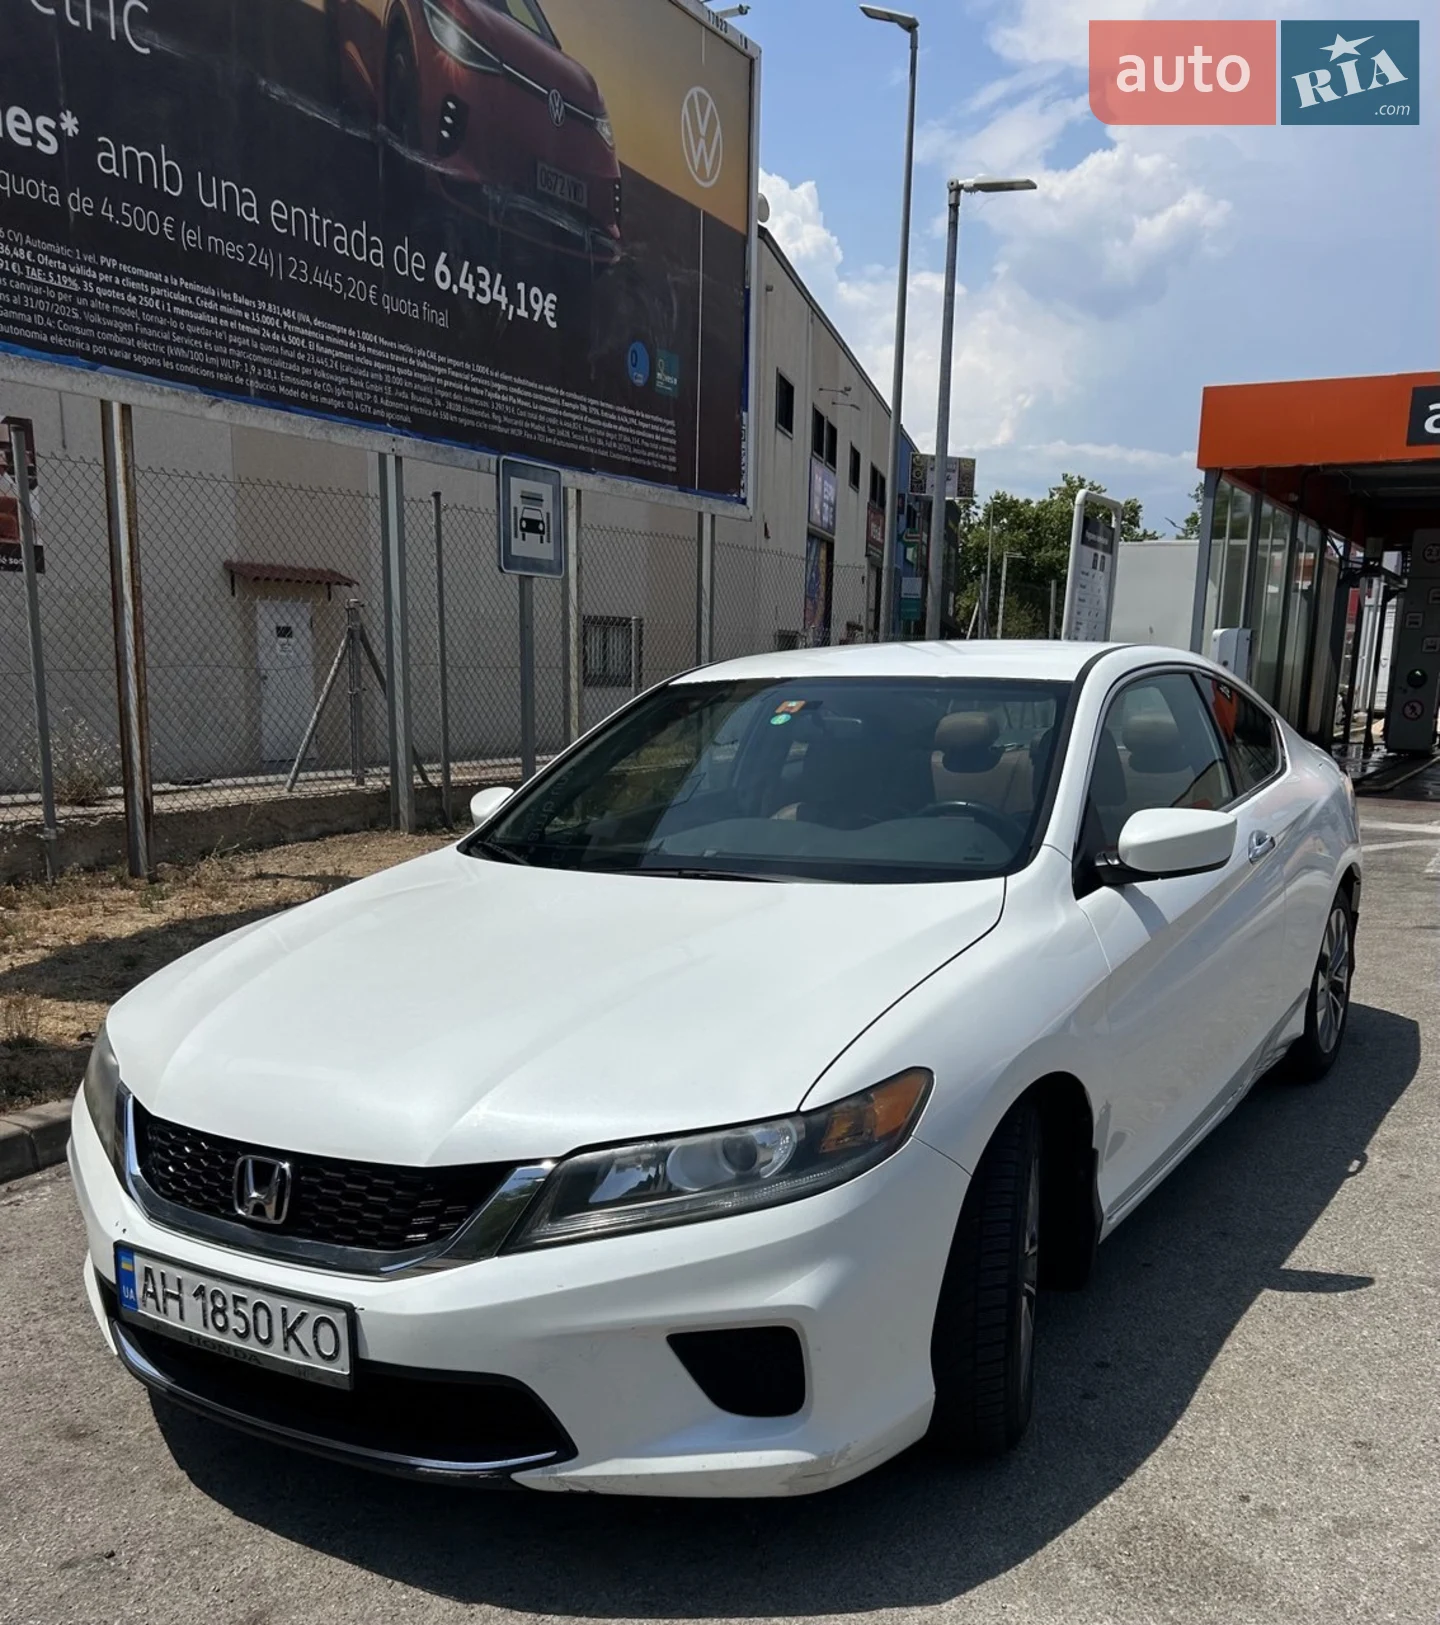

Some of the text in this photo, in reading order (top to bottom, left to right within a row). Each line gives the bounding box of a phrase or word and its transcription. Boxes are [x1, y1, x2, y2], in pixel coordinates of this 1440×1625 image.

[0, 169, 60, 206] quota
[67, 187, 94, 216] de
[100, 197, 175, 241] 4.500€
[181, 219, 203, 252] (el
[208, 236, 245, 263] mes
[288, 256, 379, 306] 23.445,20€
[381, 292, 420, 321] quota
[422, 301, 450, 329] final
[97, 136, 184, 197] amb
[198, 171, 260, 225] una
[270, 199, 385, 269] entrada
[393, 235, 426, 282] de
[434, 252, 559, 329] 6.434,19€
[37, 252, 67, 270] Oferta
[98, 271, 113, 283] per
[114, 276, 120, 285] a
[121, 277, 148, 292] clients
[150, 286, 194, 304] particulars.
[99, 255, 117, 269] PVP
[118, 262, 162, 282] recomanat
[163, 275, 169, 284] a
[170, 275, 177, 286] la
[9, 280, 55, 299] canviar-lo
[57, 292, 71, 303] per
[76, 296, 88, 307] un
[89, 298, 110, 312] altre
[112, 305, 140, 321] model,
[179, 322, 184, 330] o
[24, 265, 46, 280] TAE:
[82, 280, 93, 293] 35
[95, 286, 125, 301] quotes
[126, 292, 136, 304] de
[219, 318, 228, 328] en
[229, 320, 236, 330] el
[56, 319, 94, 338] Consum
[83, 310, 133, 332] Volkswagen
[135, 323, 170, 341] Financial
[171, 332, 202, 348] Services
[92, 343, 106, 354] pot
[132, 353, 161, 366] segons
[162, 357, 173, 369] les
[122, 1285, 136, 1302] UA
[140, 1264, 341, 1364] AH 1850 KO
